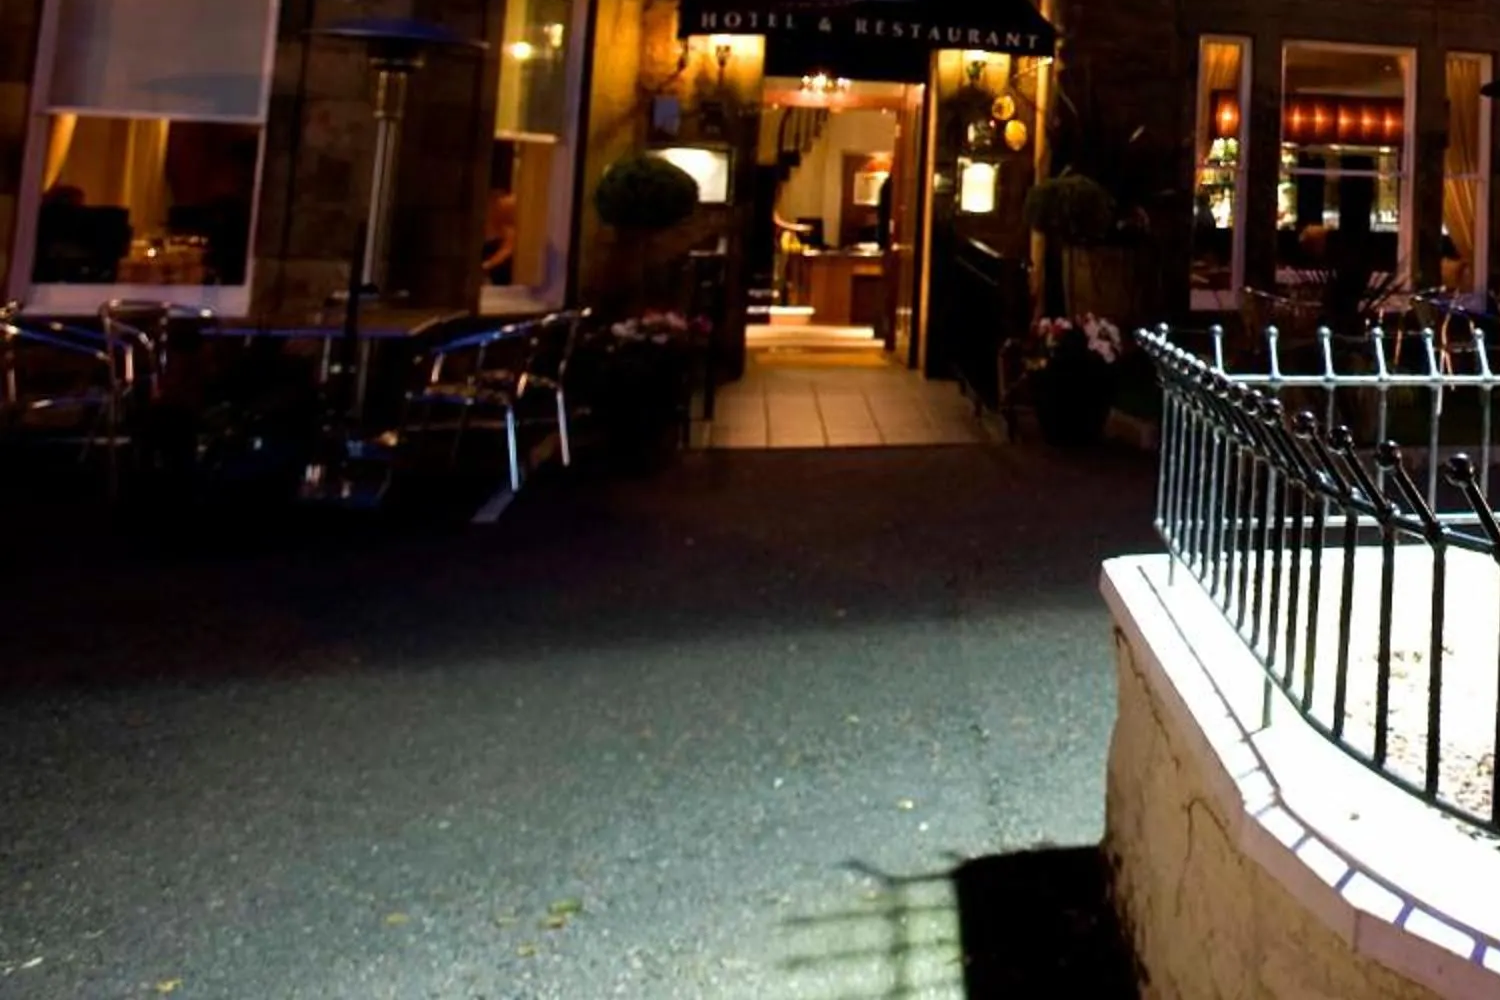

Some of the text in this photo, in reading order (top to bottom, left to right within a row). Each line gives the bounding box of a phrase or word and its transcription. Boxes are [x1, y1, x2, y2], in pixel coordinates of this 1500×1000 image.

[700, 11, 1041, 50] HOTEL & RESTAURANT
